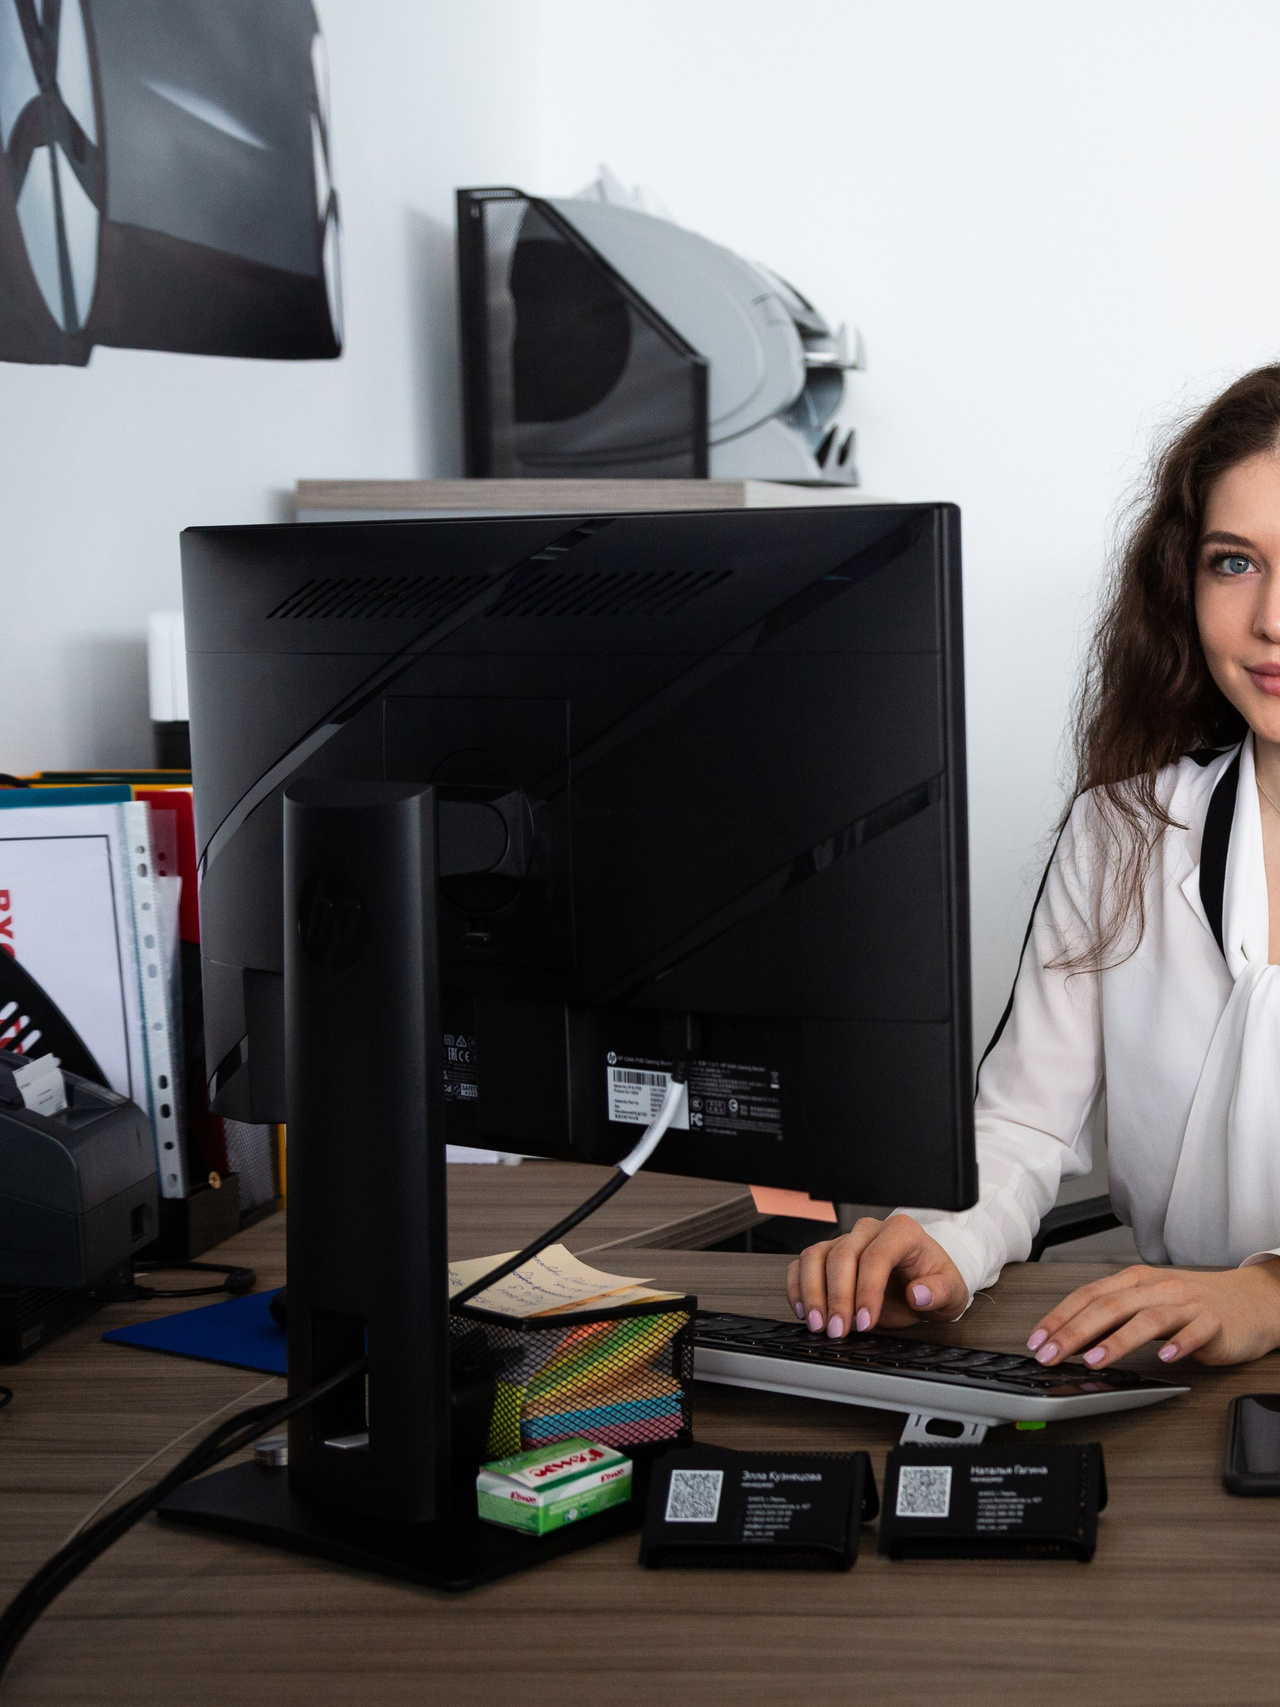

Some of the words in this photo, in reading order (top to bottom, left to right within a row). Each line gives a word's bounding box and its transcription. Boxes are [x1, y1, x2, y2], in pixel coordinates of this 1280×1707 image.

[741, 1469, 767, 1481] Элла
[768, 1470, 822, 1483] Кузнецова
[970, 1465, 1013, 1476] Наталья
[1013, 1464, 1048, 1475] Гагина
